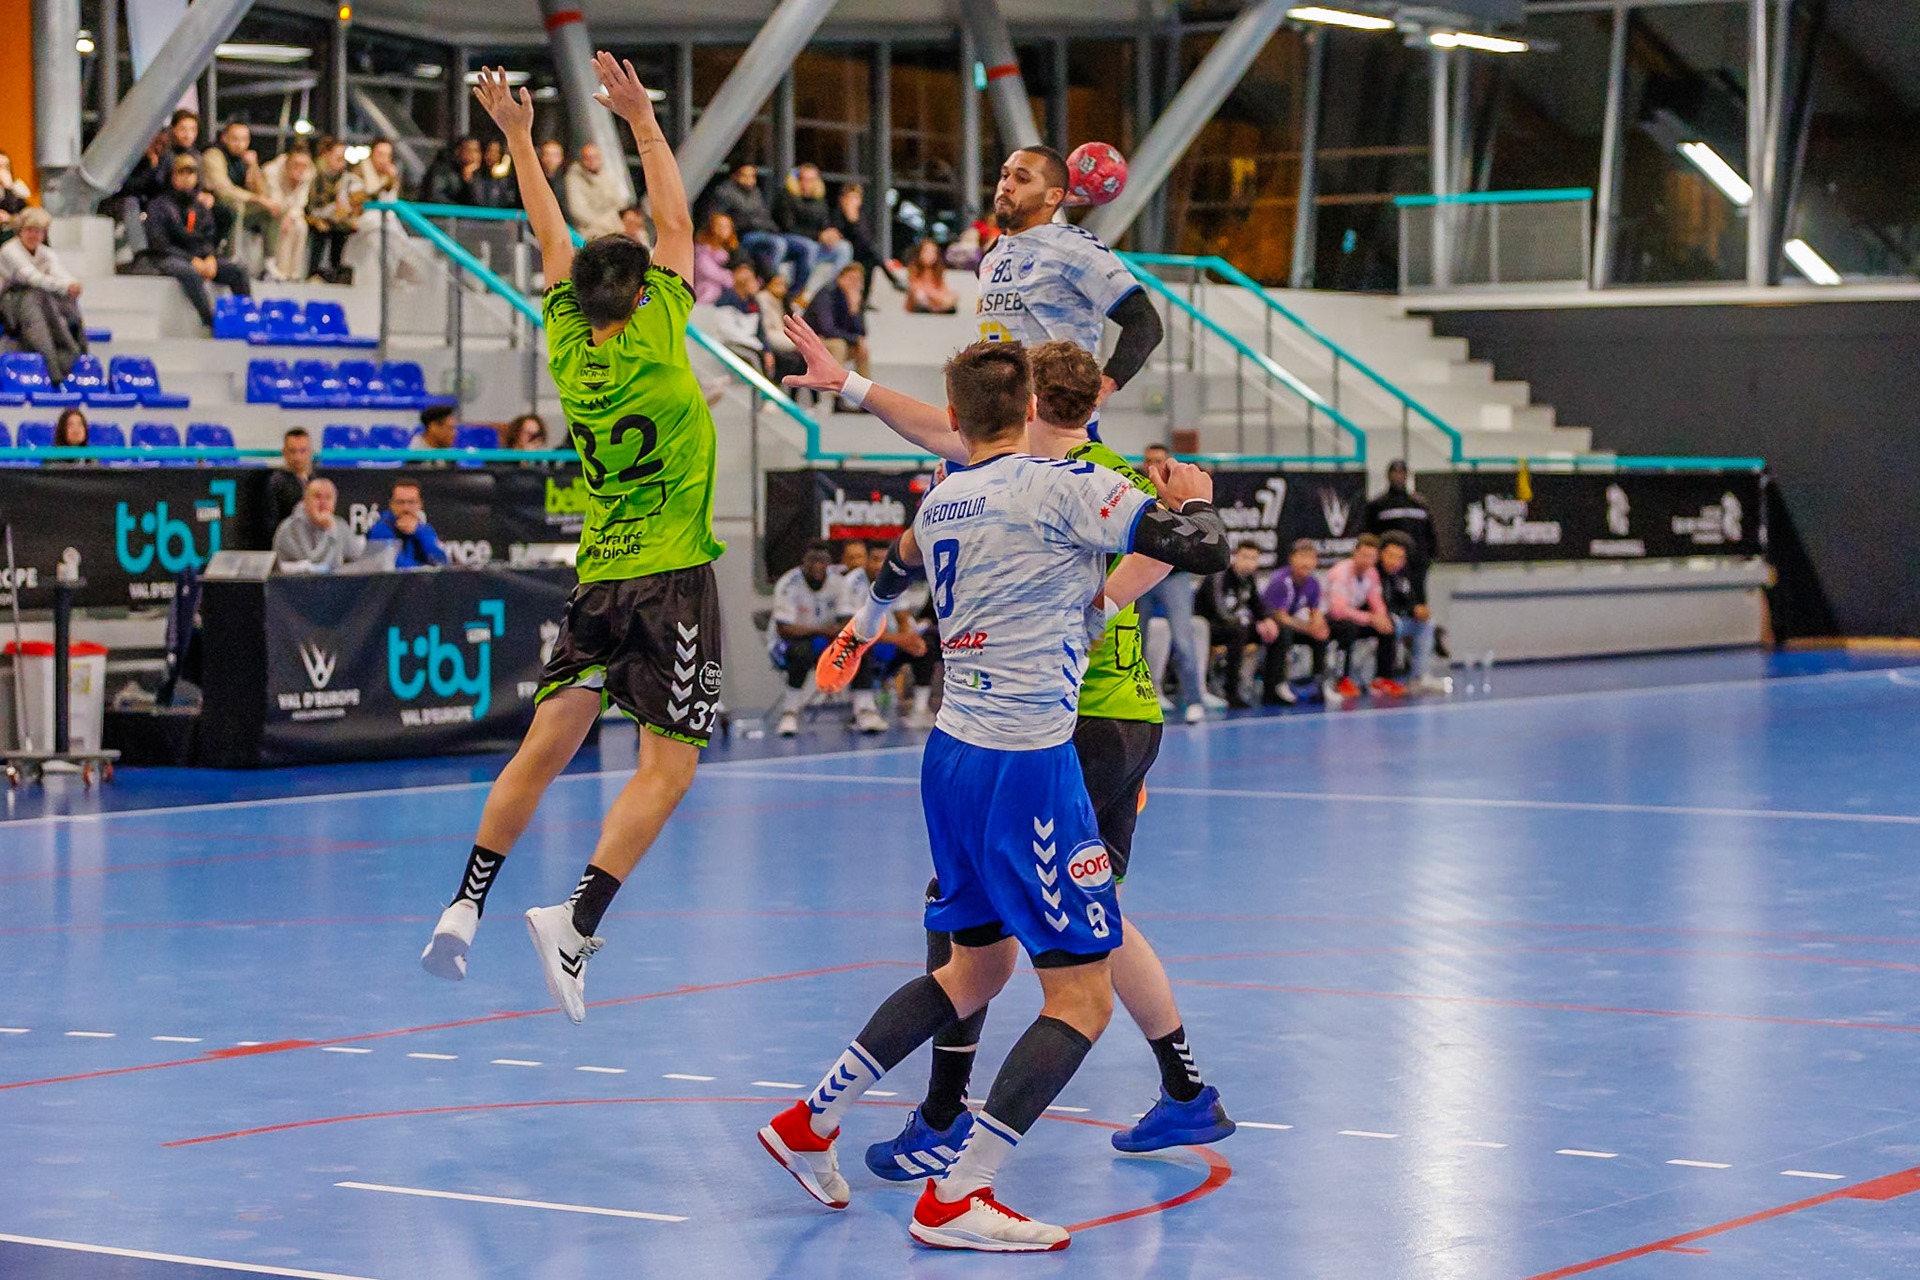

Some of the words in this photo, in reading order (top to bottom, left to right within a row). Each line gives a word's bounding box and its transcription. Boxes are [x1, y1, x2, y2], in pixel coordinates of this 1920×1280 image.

[571, 414, 664, 489] 32
[689, 700, 718, 732] 32
[1086, 901, 1110, 938] 9
